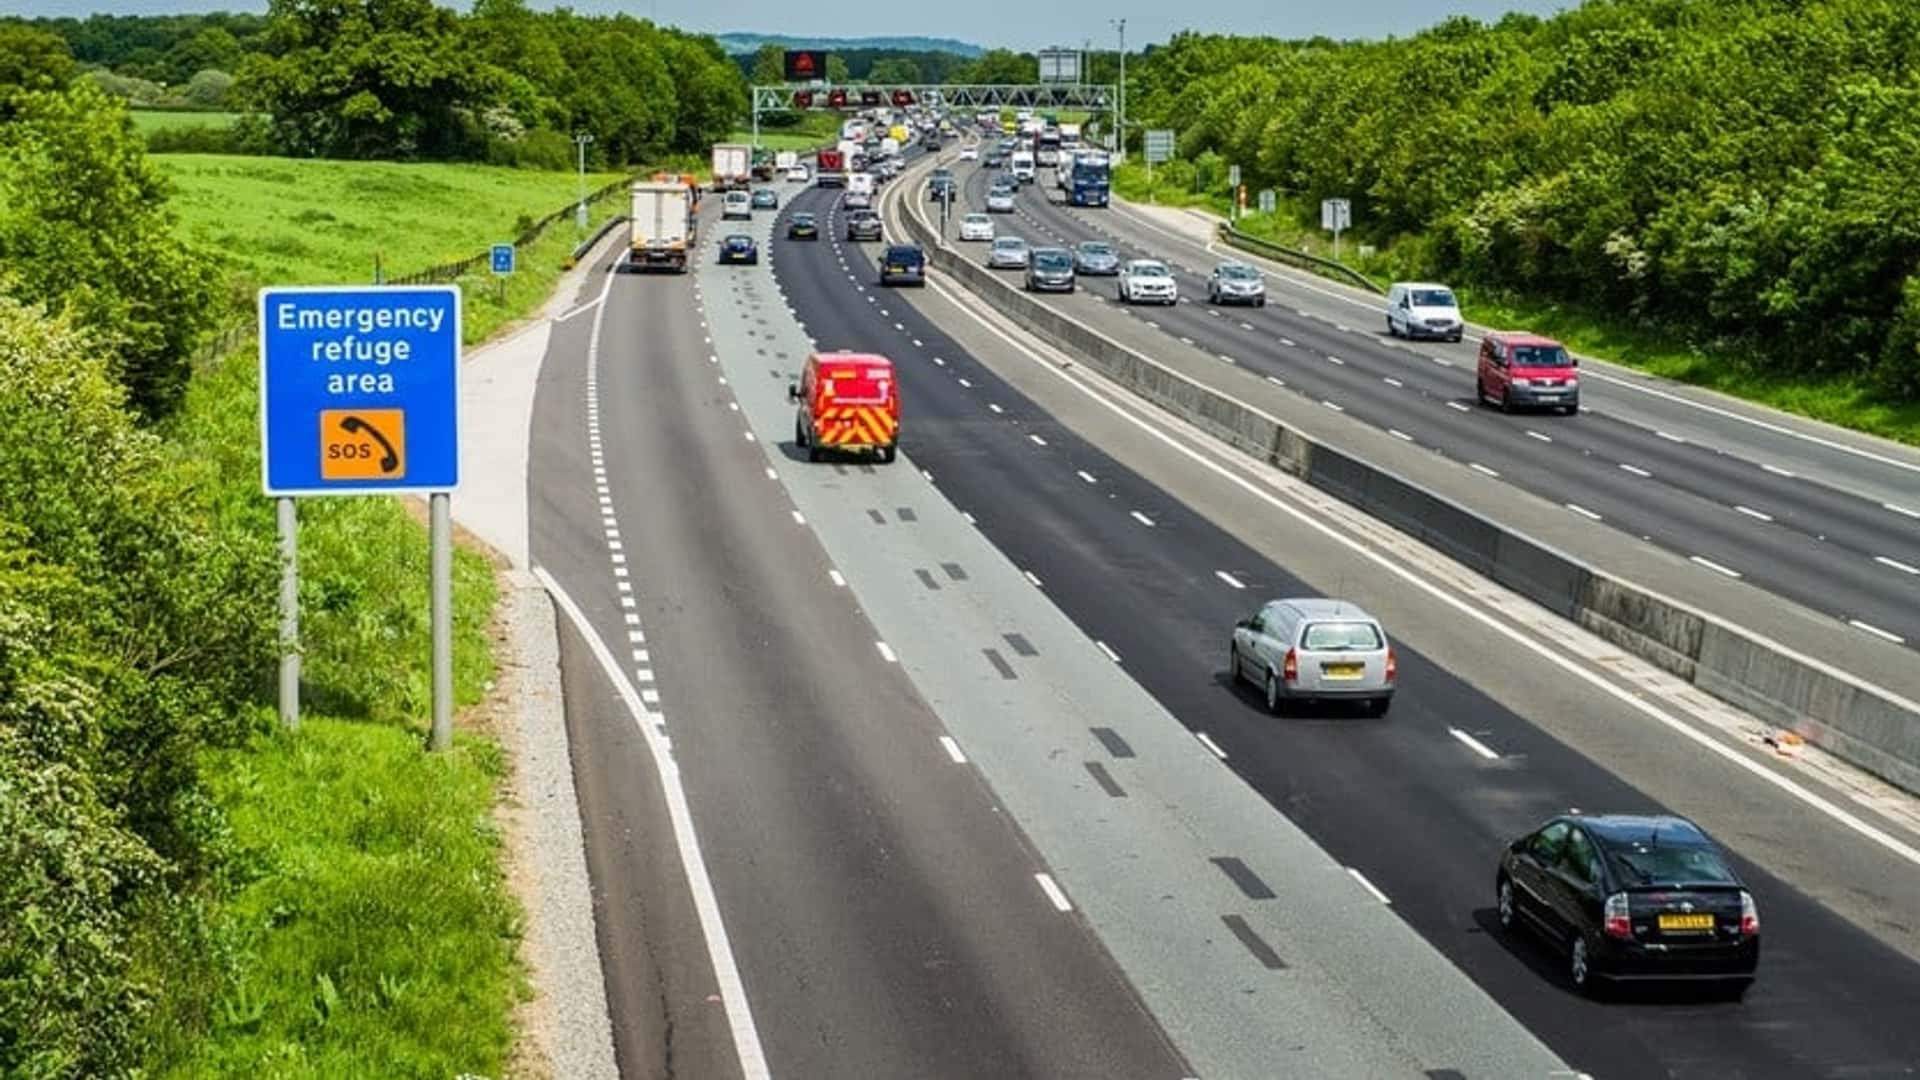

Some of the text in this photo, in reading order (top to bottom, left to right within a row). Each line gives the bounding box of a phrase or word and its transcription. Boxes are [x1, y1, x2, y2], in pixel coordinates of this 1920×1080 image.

[278, 303, 444, 332] Emergency
[312, 336, 411, 364] refuge
[328, 373, 394, 394] area
[327, 443, 371, 459] SOS
